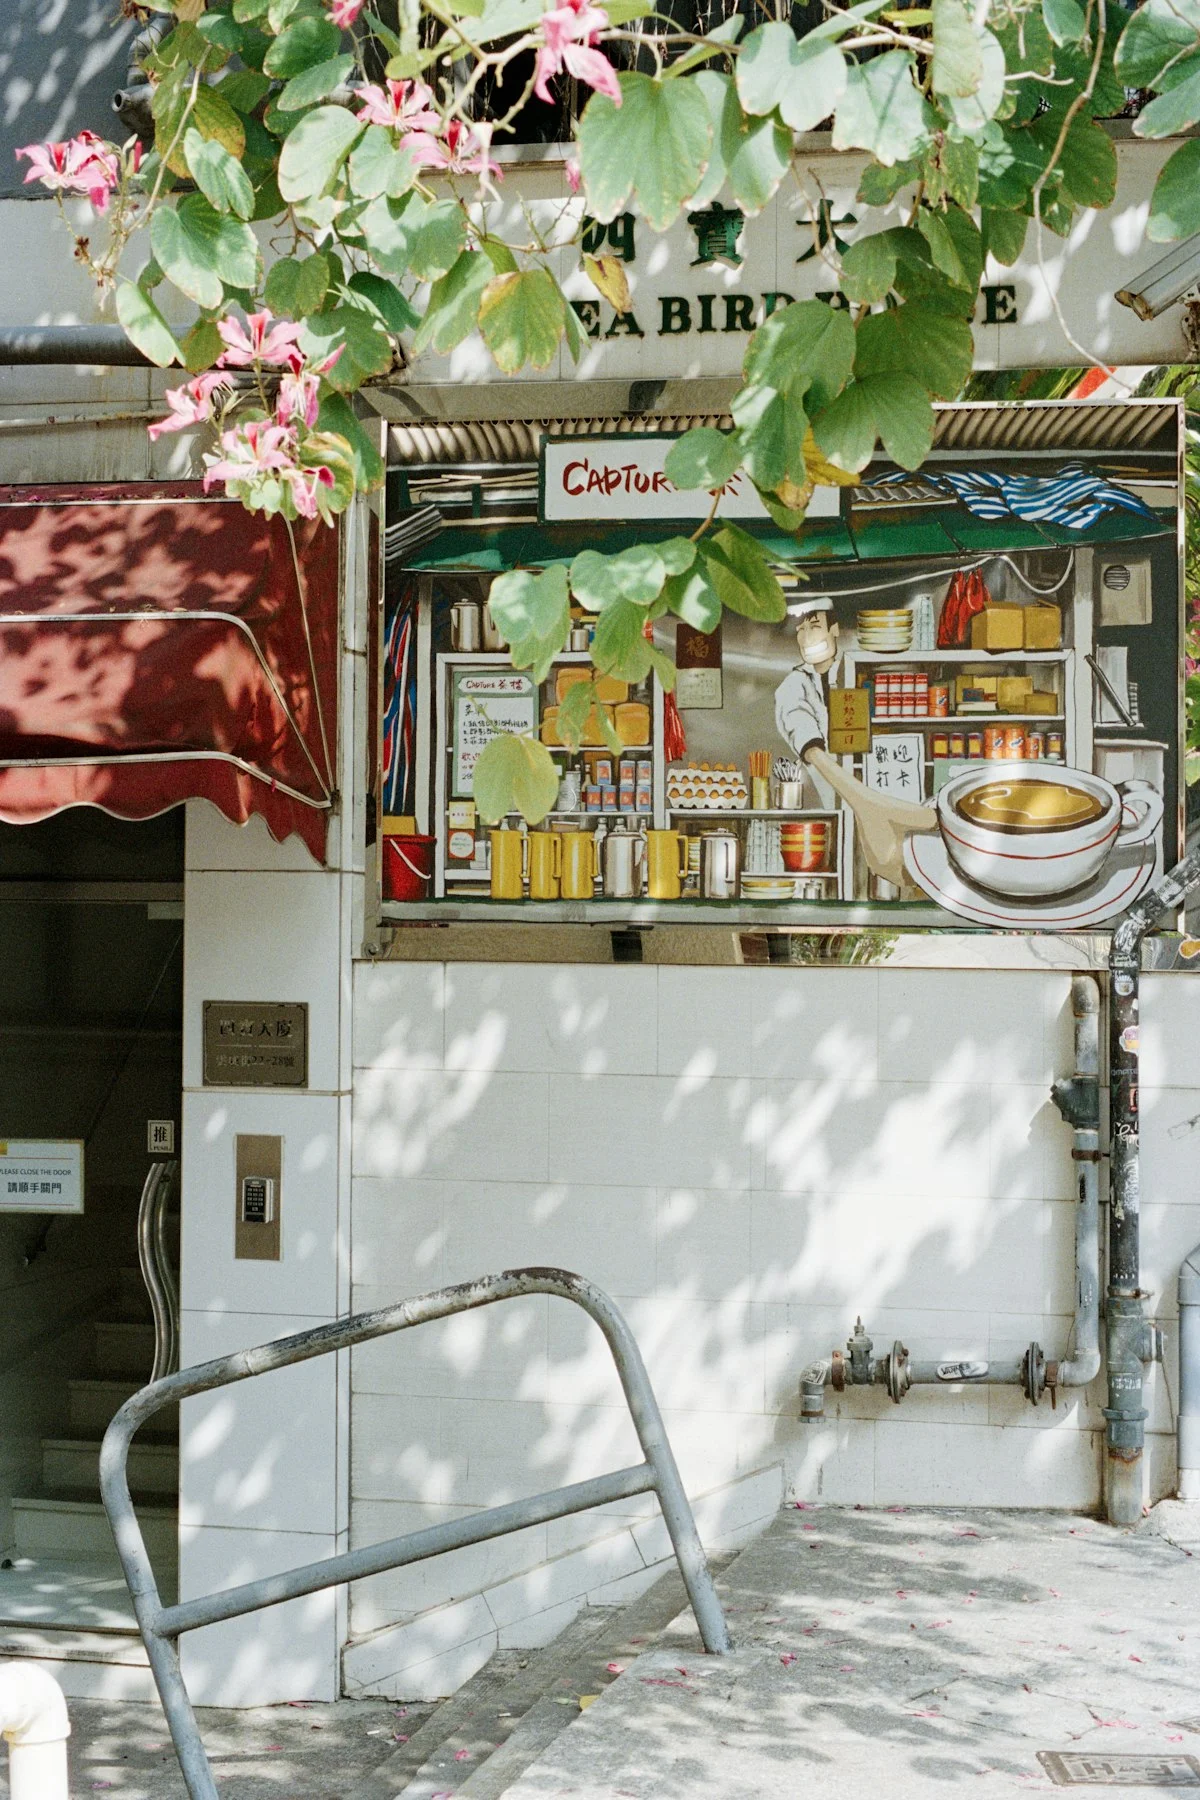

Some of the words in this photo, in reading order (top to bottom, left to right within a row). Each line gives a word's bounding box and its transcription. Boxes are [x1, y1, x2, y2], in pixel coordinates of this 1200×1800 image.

[562, 457, 679, 496] CAPTUR
[876, 769, 911, 788] 打卡
[153, 1126, 168, 1142] 推
[7, 1182, 62, 1194] 請順手關門
